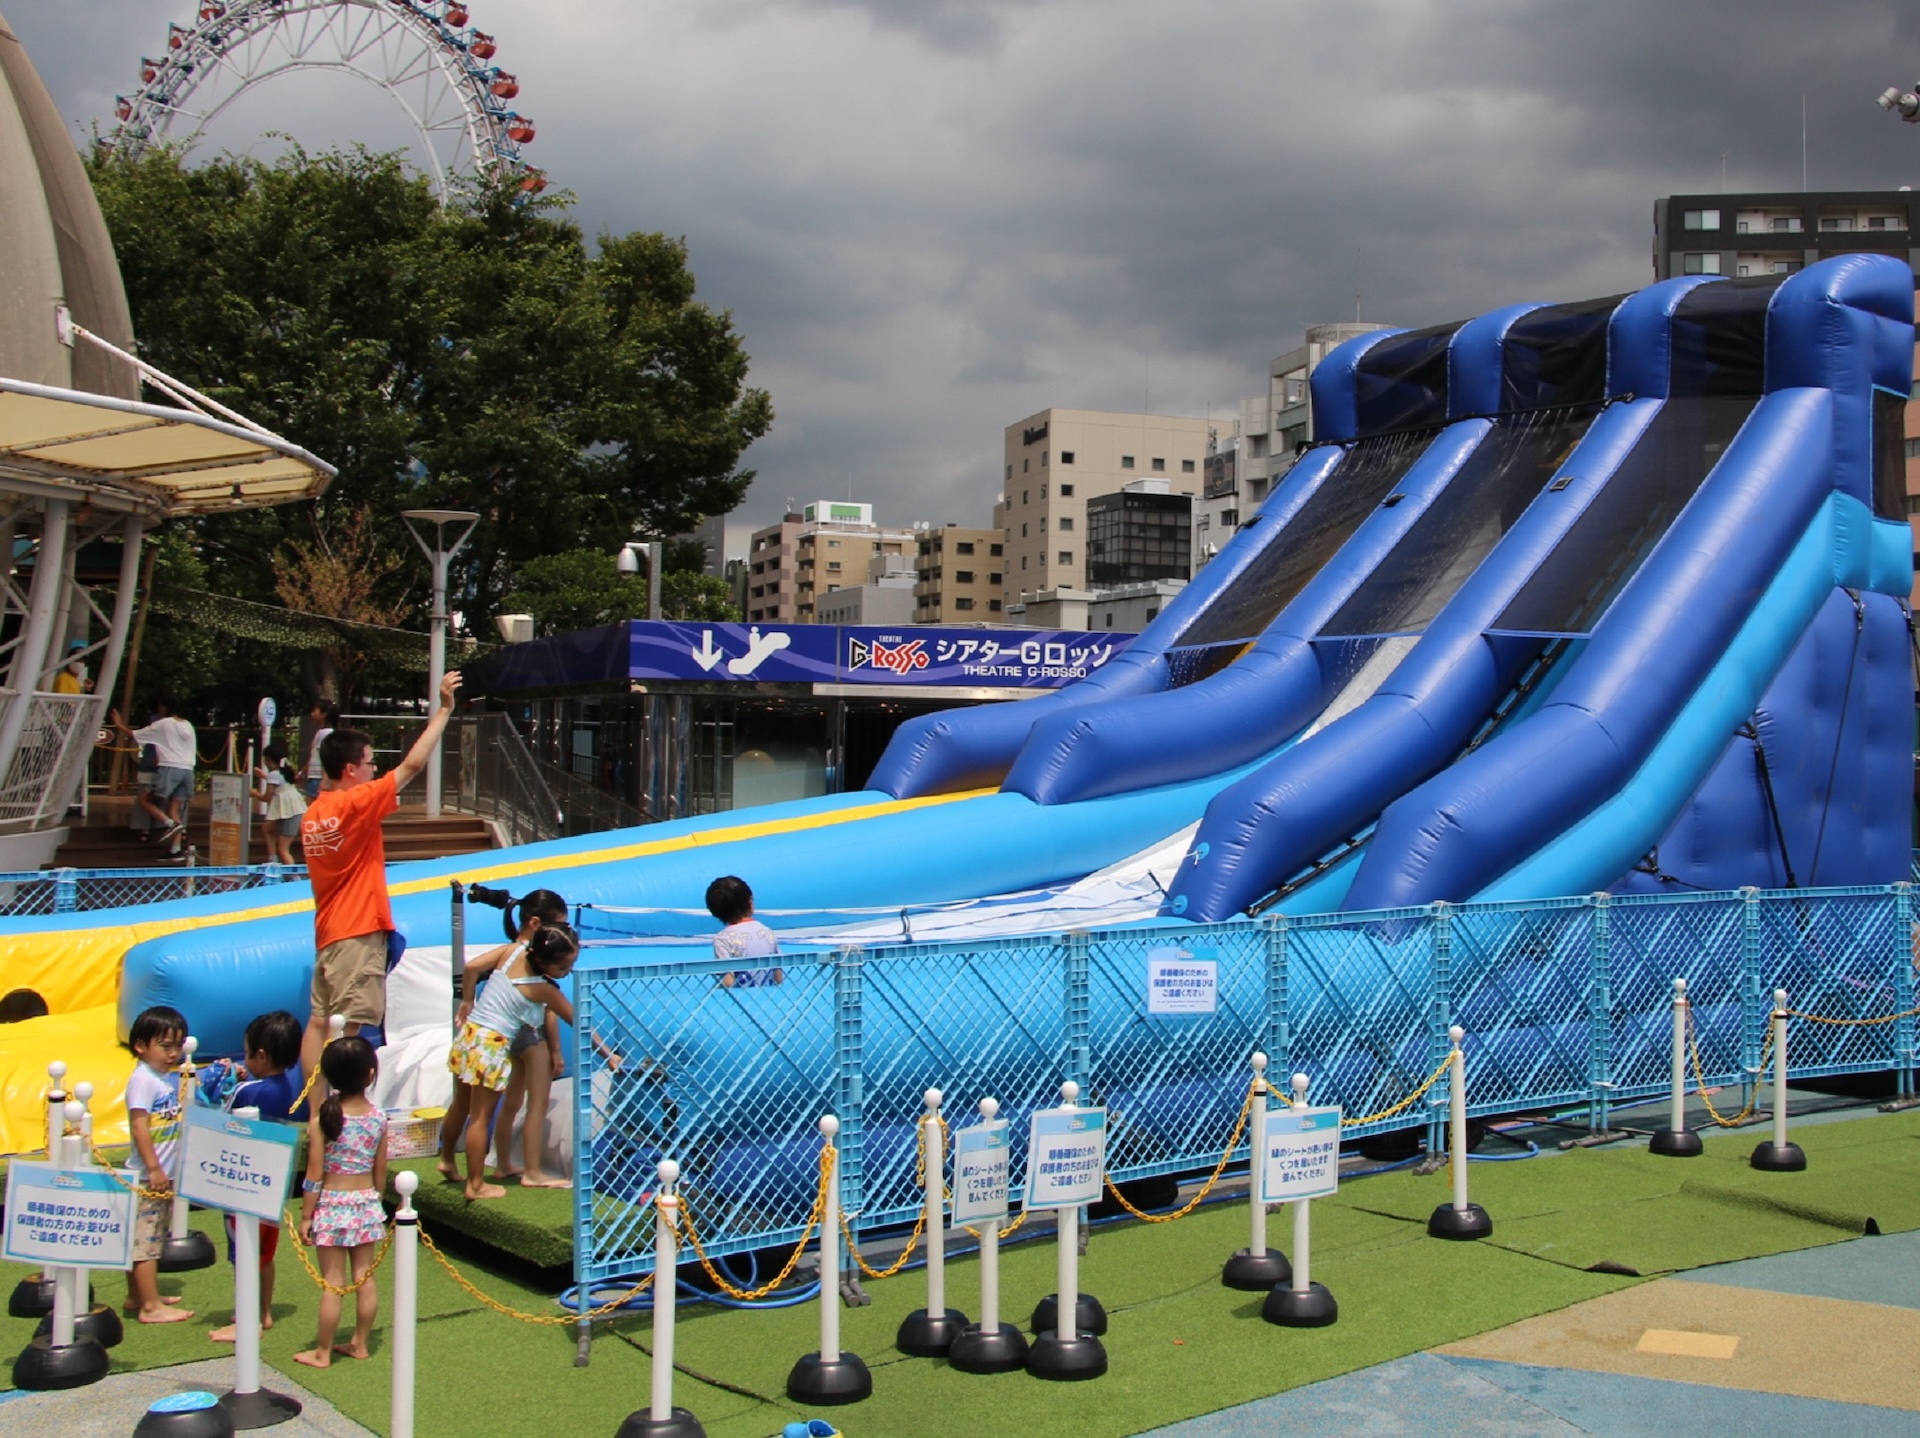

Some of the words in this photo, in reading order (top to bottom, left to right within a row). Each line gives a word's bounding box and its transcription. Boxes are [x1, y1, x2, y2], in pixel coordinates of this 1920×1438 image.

[936, 639, 1113, 668] シアターGロッソ
[962, 665, 1022, 677] THEATRE
[1027, 666, 1087, 678] G-ROSSO
[220, 1149, 251, 1167] ここに
[200, 1161, 272, 1187] くつをおいてね
